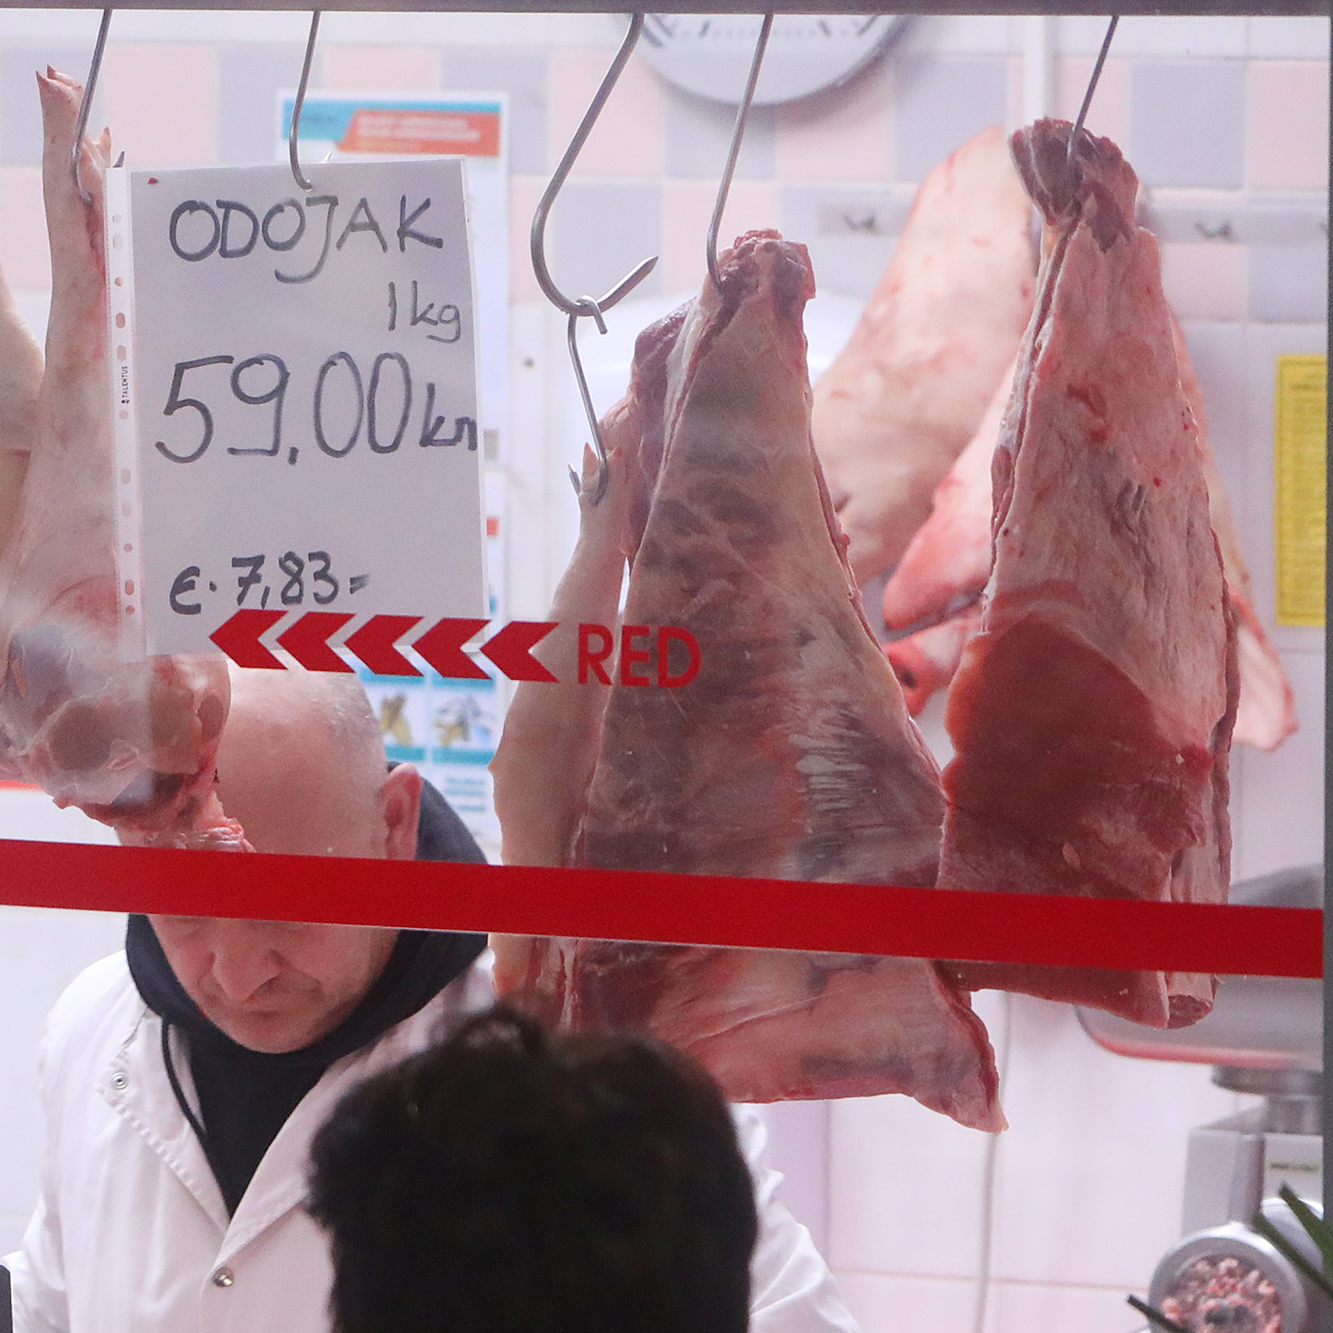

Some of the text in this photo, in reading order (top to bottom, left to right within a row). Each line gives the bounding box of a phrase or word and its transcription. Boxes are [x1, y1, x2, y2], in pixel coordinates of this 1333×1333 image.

[168, 194, 444, 285] ODOJAK
[418, 381, 479, 452] kn
[577, 623, 702, 689] RED
